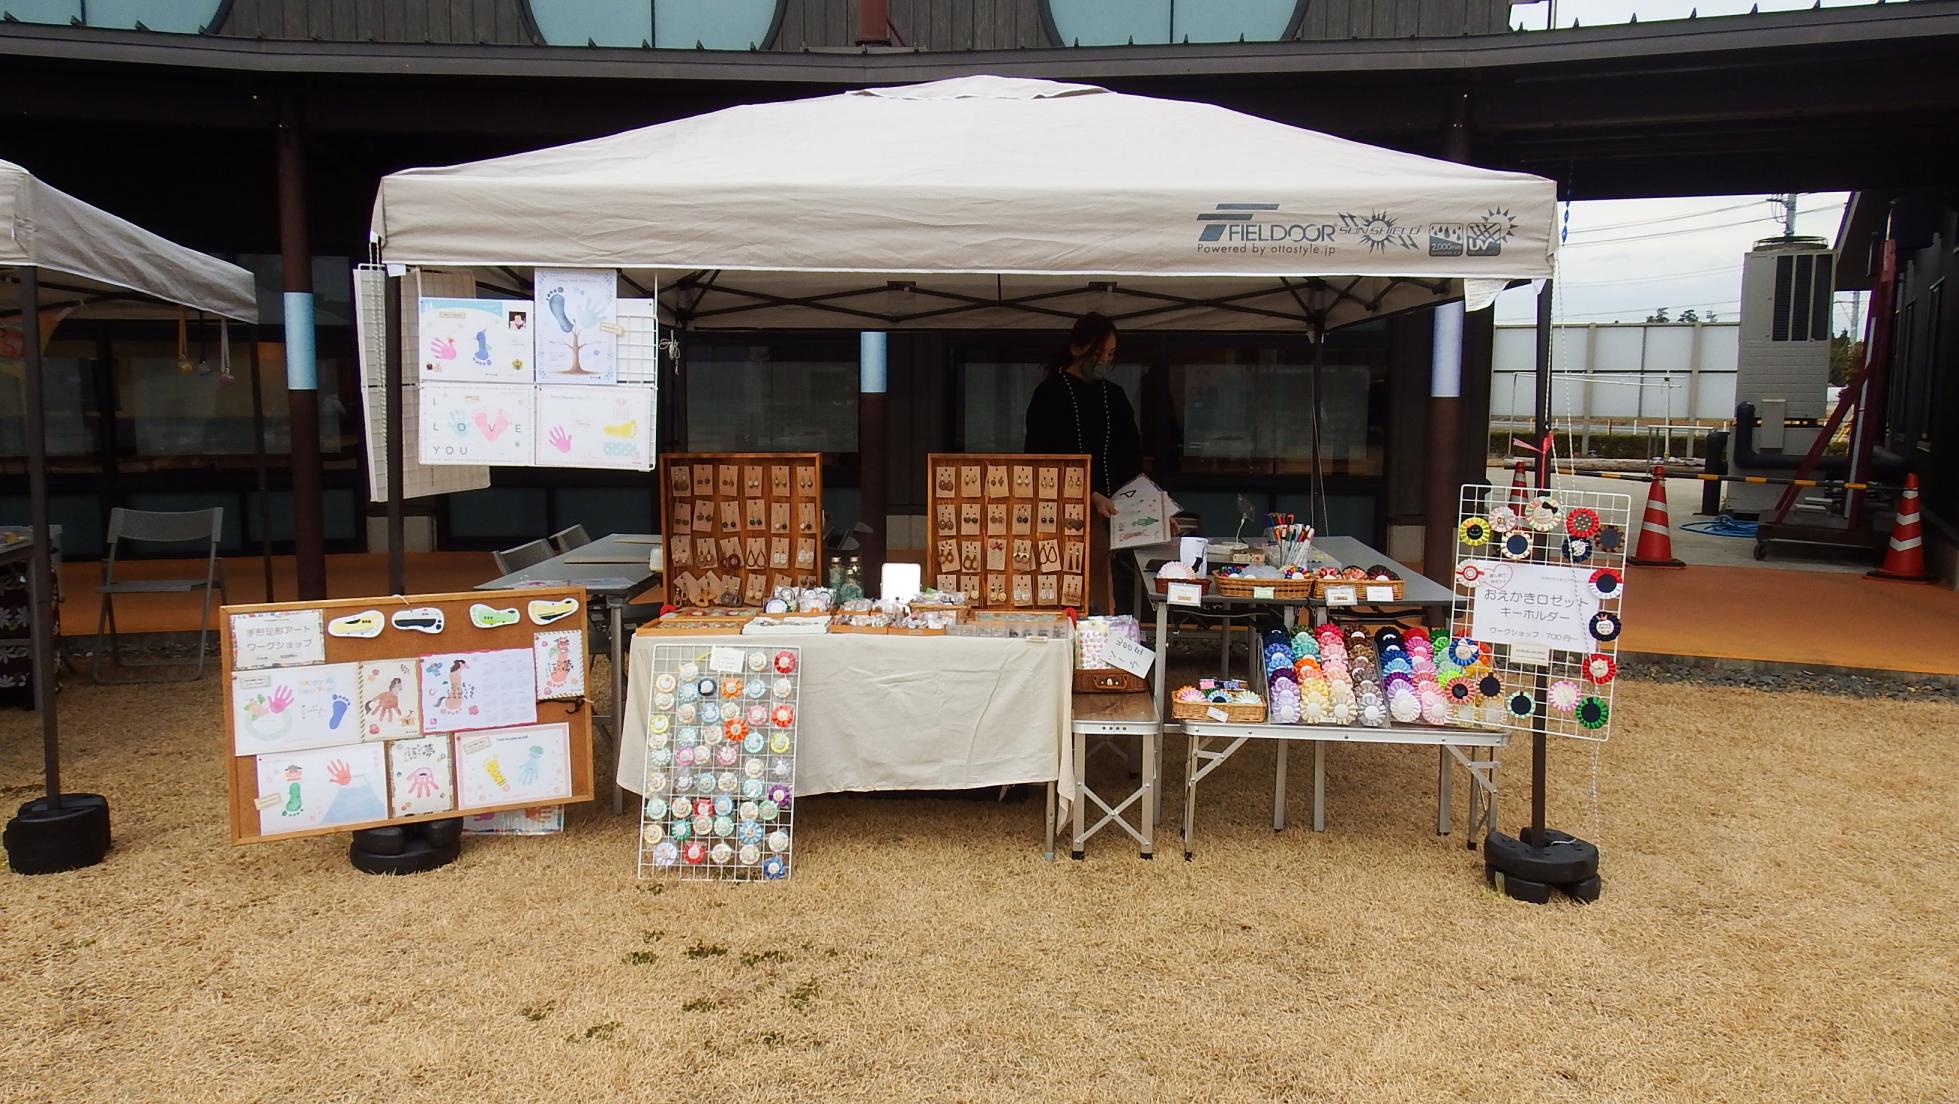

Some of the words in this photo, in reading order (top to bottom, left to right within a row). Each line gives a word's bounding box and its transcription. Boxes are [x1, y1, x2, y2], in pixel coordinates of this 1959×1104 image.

[1228, 223, 1336, 243] FIELDOOR
[1197, 243, 1247, 254] Powered
[1252, 244, 1267, 256] by
[1270, 243, 1336, 257] ottostyle.jp
[1469, 238, 1491, 251] UV
[1484, 588, 1590, 608] おえかきロゼット
[1500, 606, 1571, 622] キーホルダー
[1489, 626, 1540, 639] ワークショップ
[246, 639, 312, 652] ワークショップ
